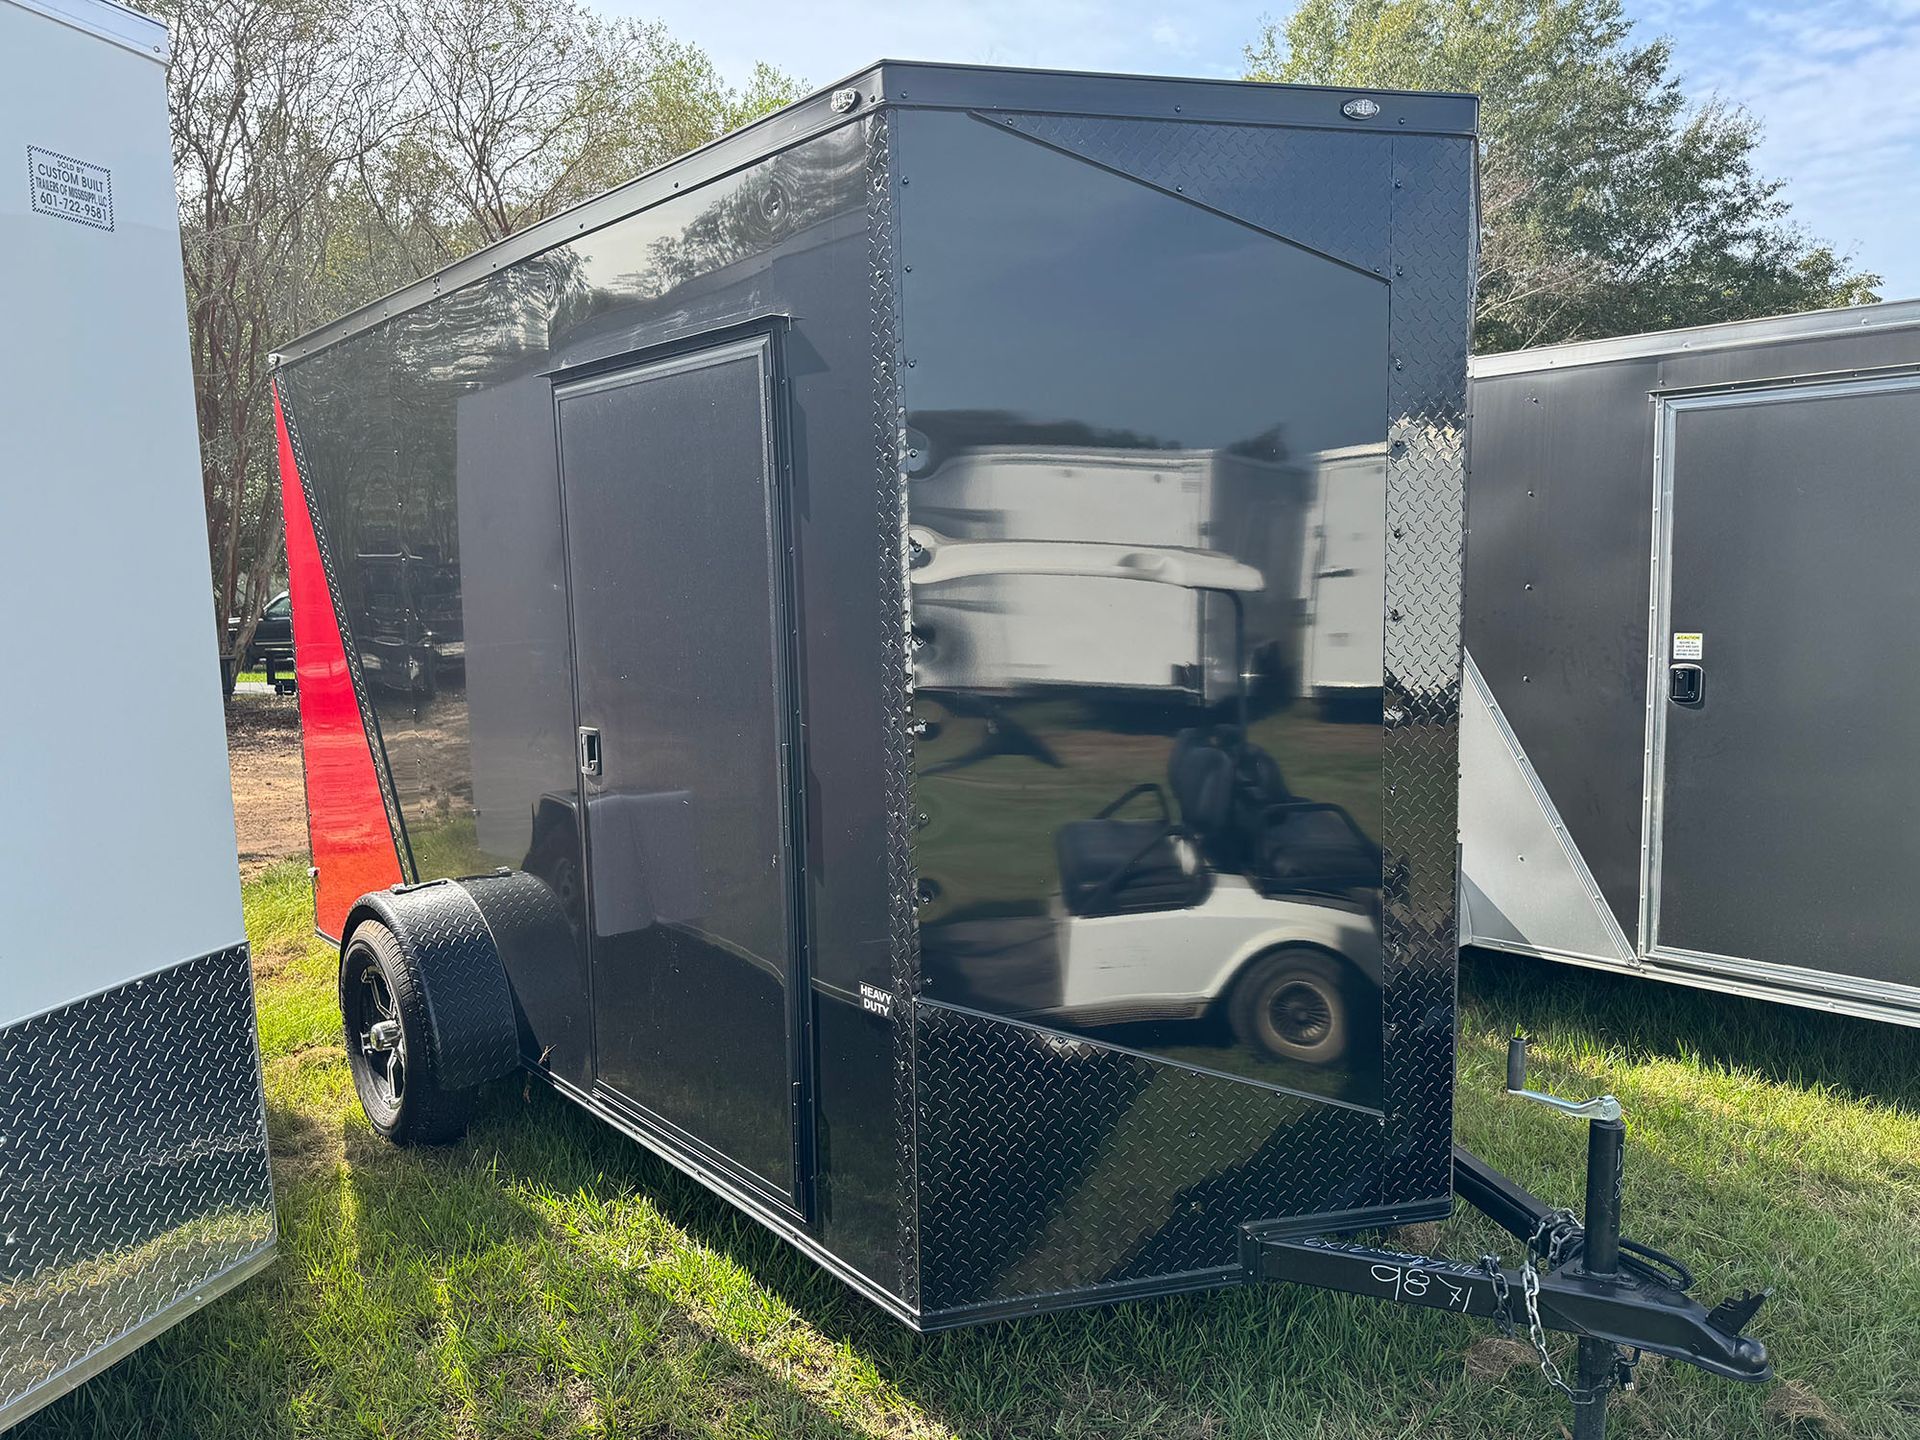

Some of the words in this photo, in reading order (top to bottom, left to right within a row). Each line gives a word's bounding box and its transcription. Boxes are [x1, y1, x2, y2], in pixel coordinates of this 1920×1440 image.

[57, 160, 75, 171] SOLD
[76, 166, 85, 174] BY
[35, 176, 59, 193] TRAILERS
[60, 183, 67, 196] OF
[38, 163, 79, 186] CUSTOM
[81, 176, 103, 193] BUILT
[40, 192, 107, 221] 601-722-9581
[860, 984, 892, 1005] HEAVY
[863, 997, 890, 1017] DUTY
